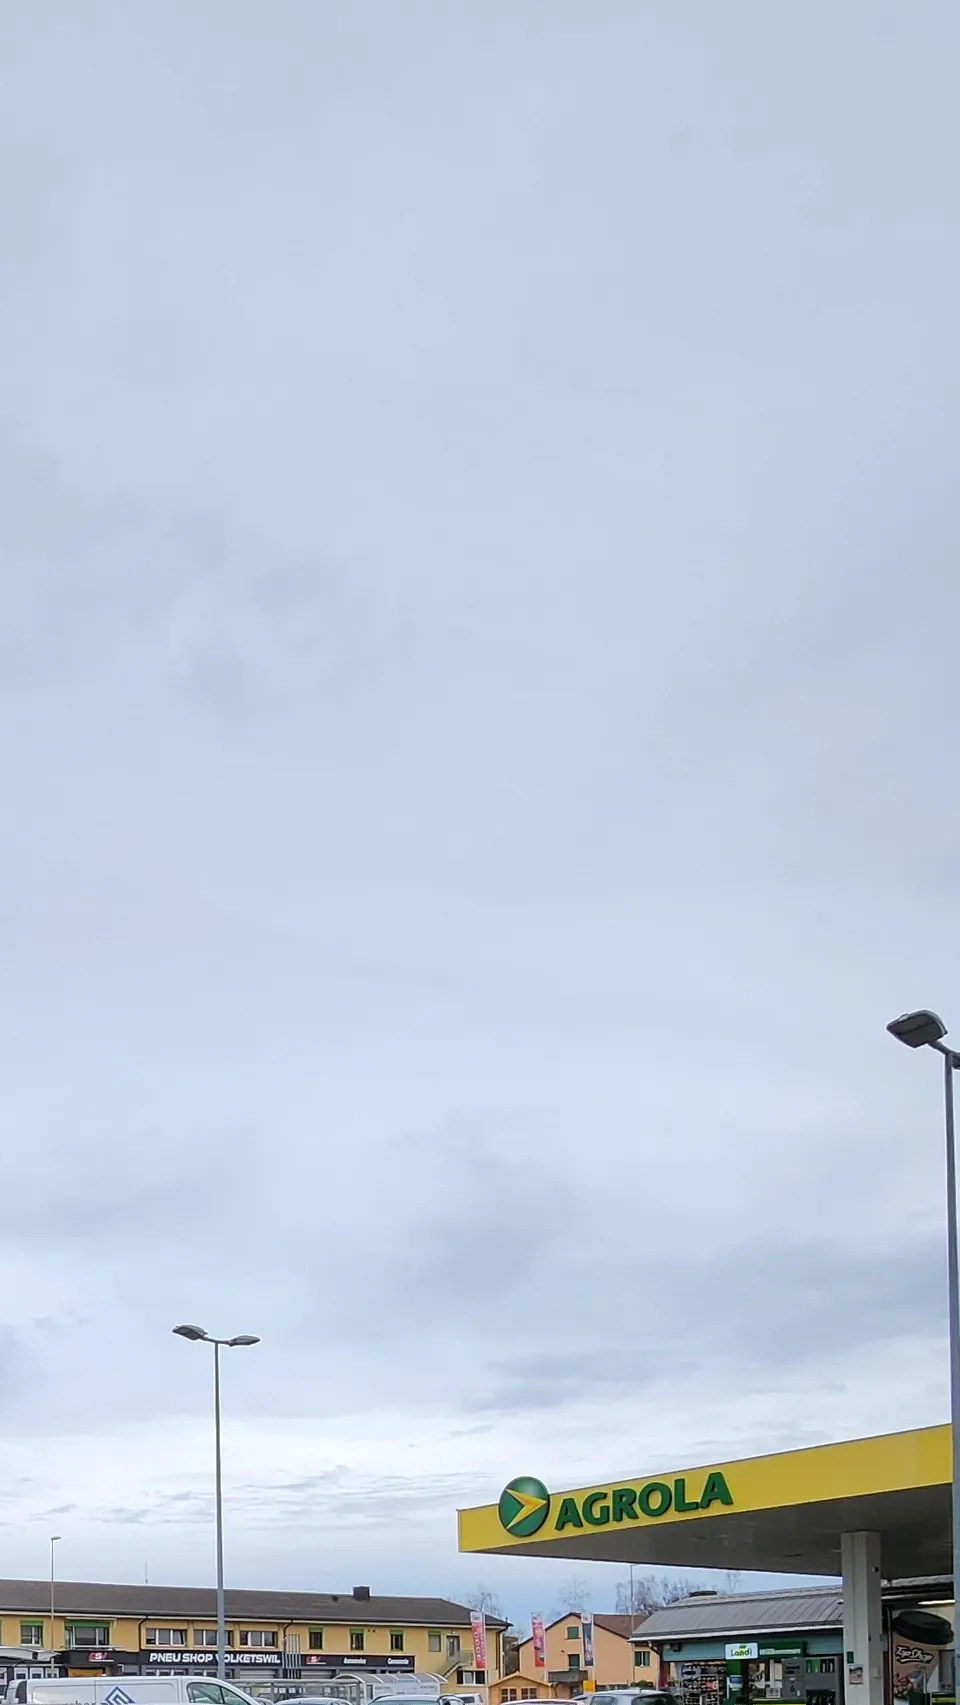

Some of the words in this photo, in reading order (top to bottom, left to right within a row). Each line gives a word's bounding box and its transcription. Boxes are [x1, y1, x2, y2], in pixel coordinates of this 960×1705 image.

[554, 1471, 735, 1531] AGROLA
[149, 1652, 181, 1663] PNEU
[182, 1652, 214, 1663] SHOP
